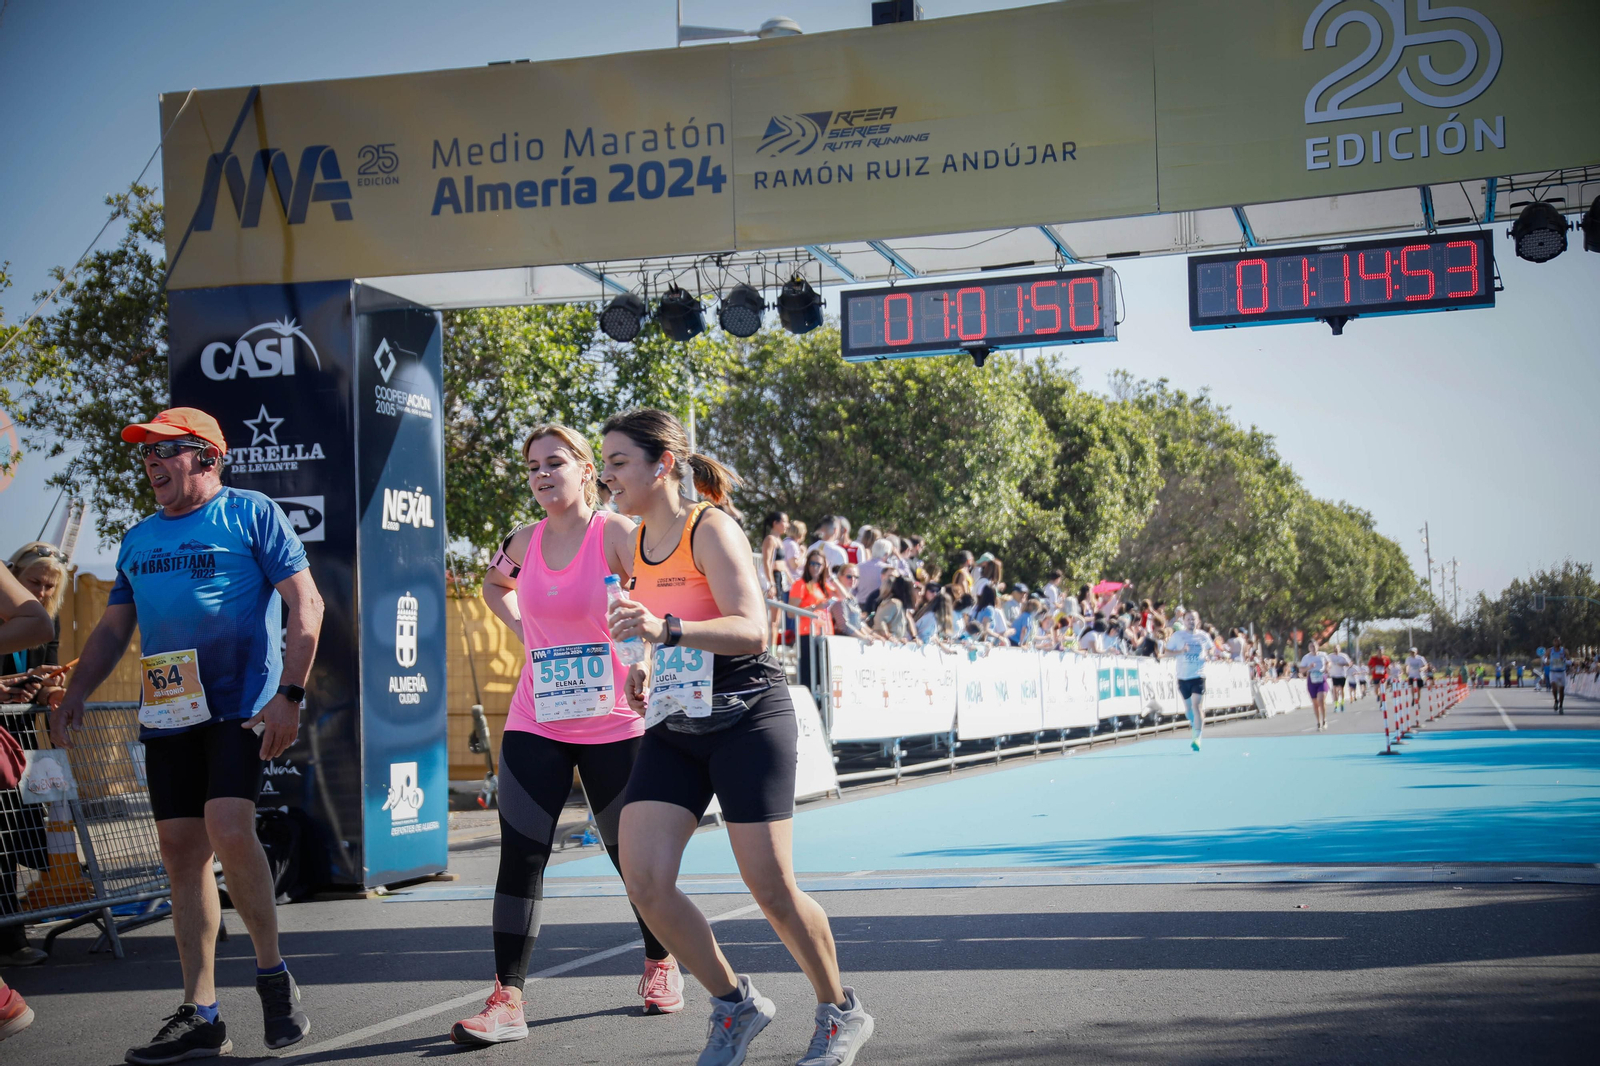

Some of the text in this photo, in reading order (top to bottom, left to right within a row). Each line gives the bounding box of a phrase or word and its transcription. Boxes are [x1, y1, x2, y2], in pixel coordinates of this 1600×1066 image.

[1302, 0, 1503, 124] 25
[833, 106, 898, 126] RFEA
[432, 117, 725, 169] Medio Maratón
[822, 133, 931, 152] RUTA RUNNING
[827, 124, 892, 138] SERIES
[1305, 113, 1506, 170] EDICIÓN
[357, 143, 399, 175] 25
[755, 142, 1078, 190] RAMÓN RUIZ ANDÚJAR
[357, 174, 399, 187] EDICIÓN
[430, 155, 727, 216] Almería 2024
[1235, 240, 1478, 315] 01:14:53
[883, 276, 1099, 347] 01:01:50
[200, 336, 296, 380] CASI
[374, 384, 432, 412] COOPERACIÓN
[375, 399, 397, 417] 2005
[223, 442, 326, 465] STRELLA
[231, 461, 298, 474] DE LEVANTE
[148, 553, 216, 575] BASTETANA
[540, 656, 605, 683] 5510
[655, 673, 677, 683] LUCÍA
[389, 672, 429, 693] ALMERÍA
[263, 759, 302, 776] alucía
